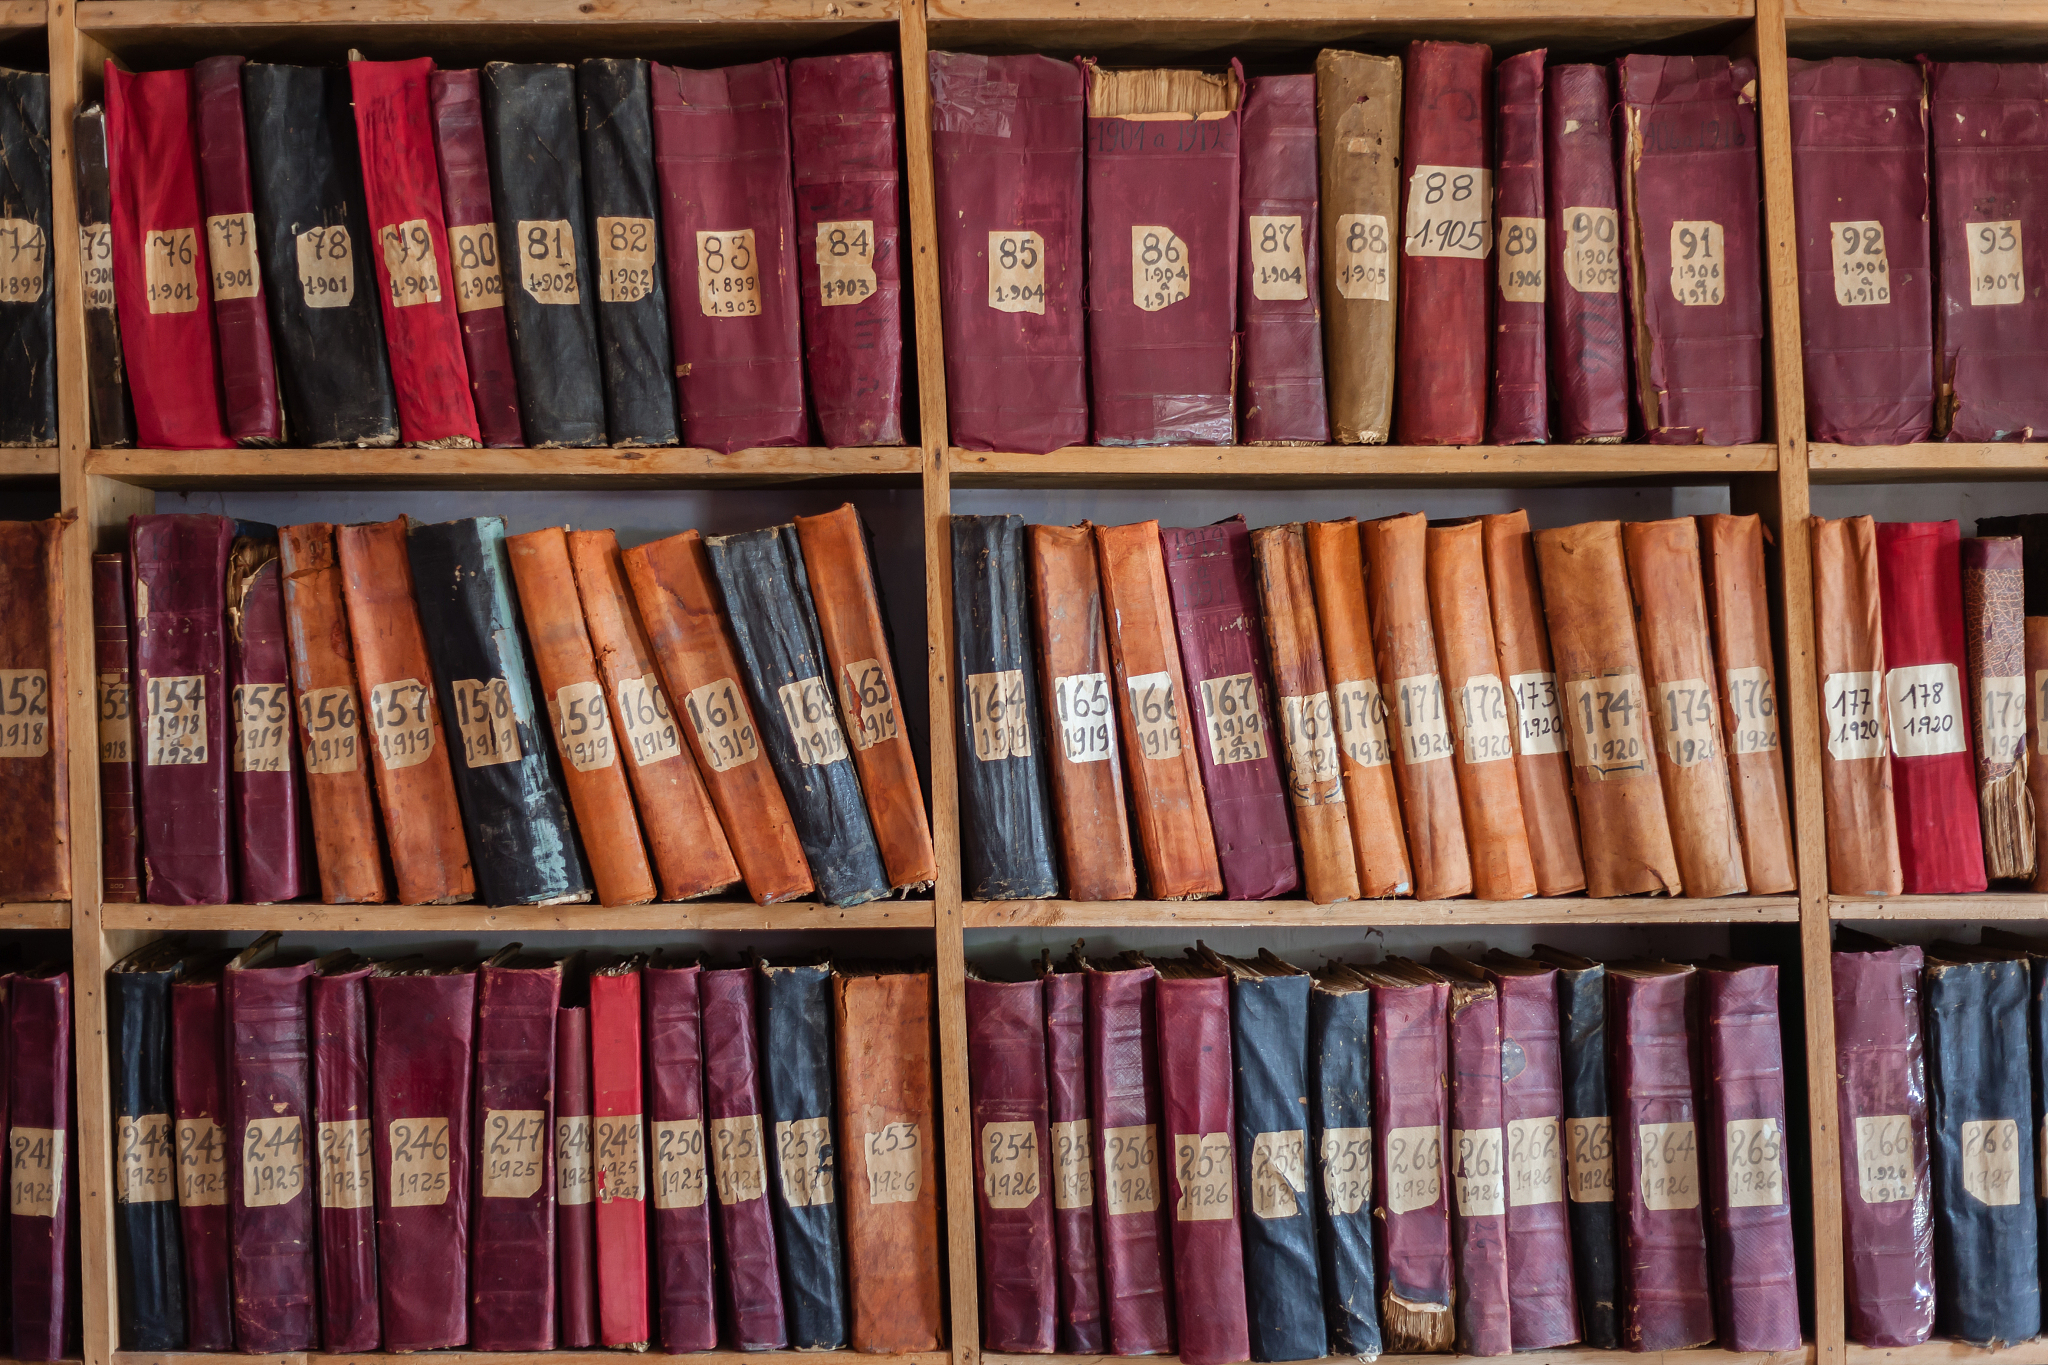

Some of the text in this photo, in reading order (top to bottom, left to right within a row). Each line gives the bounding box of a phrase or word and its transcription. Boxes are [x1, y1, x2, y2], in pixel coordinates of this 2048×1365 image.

[1426, 172, 1474, 204] 88
[213, 217, 247, 247] 77
[528, 227, 562, 259] 81
[611, 222, 646, 252] 82
[829, 229, 868, 256] 84
[1260, 223, 1295, 253] 87
[1347, 223, 1387, 253] 88
[1414, 219, 1486, 250] 1.905
[1505, 224, 1537, 256] 89
[1572, 212, 1615, 245] 90
[1679, 227, 1711, 259] 91
[1842, 226, 1883, 255] 92
[1979, 226, 2017, 255] 93
[0, 227, 45, 262] 74
[82, 231, 110, 260] 75
[154, 234, 192, 266] 76
[306, 230, 347, 259] 78
[459, 232, 496, 269] 80
[704, 236, 750, 274] 83
[1000, 238, 1037, 269] 85
[1141, 233, 1180, 265] 86
[1576, 249, 1613, 264] 1.906
[610, 269, 649, 284] 1.902
[1261, 267, 1301, 284] 1.904
[1342, 266, 1386, 284] 1.905
[1509, 270, 1542, 287] 1.906
[1842, 259, 1886, 275] 1.906
[1861, 277, 1872, 286] a
[1976, 271, 2020, 291] 1.907
[148, 282, 193, 300] 1.901
[392, 275, 439, 297] 1.901
[708, 277, 755, 294] 1.899
[996, 284, 1044, 303] 1.904
[1160, 282, 1169, 290] a
[1695, 278, 1707, 288] a
[1844, 287, 1888, 303] 1.910
[711, 300, 757, 313] 1.903
[149, 679, 204, 715] 154
[233, 687, 286, 723] 155
[687, 686, 735, 734] 161
[971, 680, 1024, 723] 164
[1058, 679, 1109, 722] 165
[1202, 677, 1253, 718] 167
[1402, 680, 1440, 726] 171
[1465, 684, 1504, 728] 172
[1517, 682, 1555, 709] 173
[1731, 679, 1773, 719] 176
[1832, 688, 1871, 717] 177
[1900, 682, 1943, 709] 178
[1985, 690, 2025, 729] 179
[301, 694, 355, 732] 156
[1580, 688, 1633, 734] 174
[1668, 690, 1710, 732] 175
[1903, 714, 1953, 736] 1.920
[1064, 723, 1109, 757] 1.919
[1215, 713, 1259, 741] 1.919
[1232, 736, 1245, 747] a
[1523, 717, 1561, 738] 1.920
[1835, 720, 1878, 743] 1.920
[309, 735, 354, 762] 1.919
[246, 1124, 301, 1163] 244
[395, 1124, 448, 1163] 246
[492, 1116, 543, 1153] 247
[659, 1130, 701, 1162] 250
[990, 1132, 1035, 1164] 254
[1512, 1124, 1557, 1163] 262
[1575, 1124, 1611, 1163] 263
[1644, 1130, 1694, 1168] 264
[1732, 1130, 1778, 1168] 265
[1862, 1122, 1908, 1160] 266
[1965, 1124, 2016, 1157] 268
[15, 1136, 52, 1169] 241
[1109, 1136, 1154, 1172] 256
[1179, 1145, 1229, 1180] 257
[1391, 1137, 1440, 1174] 260
[254, 1164, 302, 1194] 1.925
[989, 1172, 1037, 1197] 1.926
[1395, 1178, 1436, 1199] 1.926
[1517, 1167, 1551, 1191] 1.926
[1645, 1175, 1688, 1198] 1.926
[1734, 1171, 1776, 1194] 1.926
[1867, 1166, 1906, 1181] 1.926
[1182, 1183, 1228, 1209] 1.926
